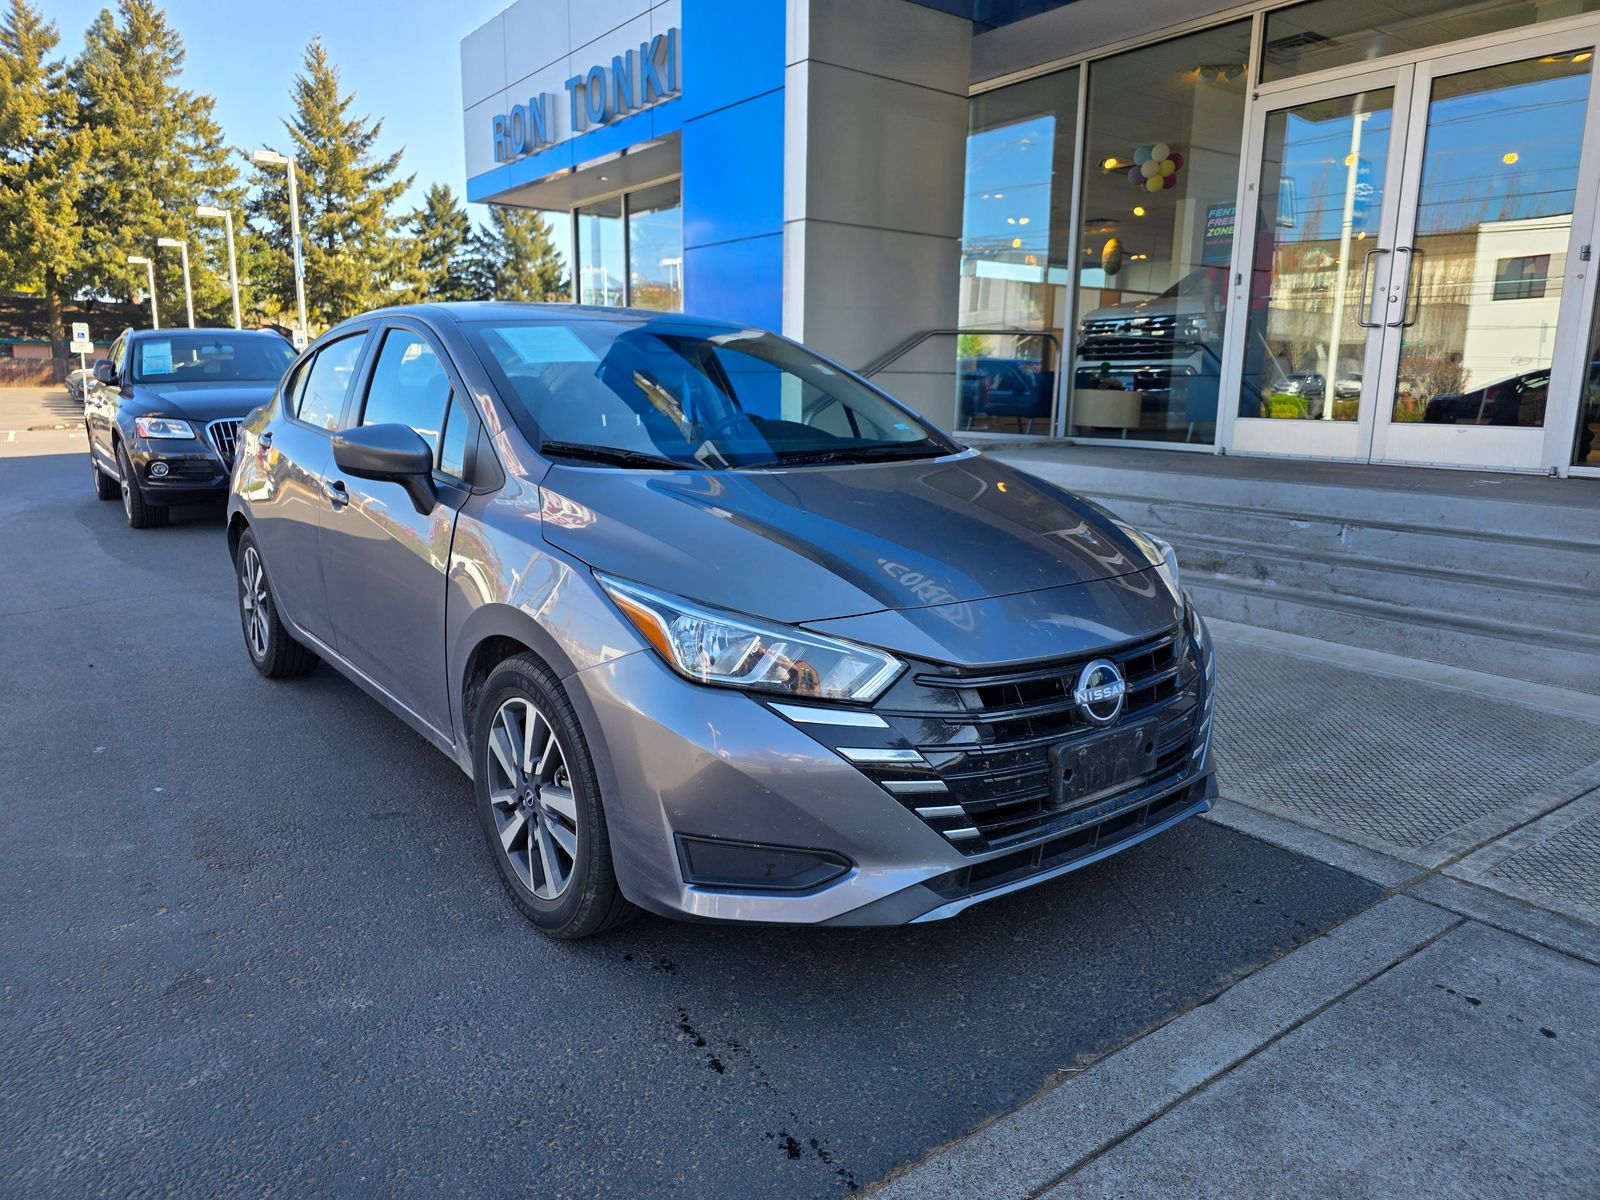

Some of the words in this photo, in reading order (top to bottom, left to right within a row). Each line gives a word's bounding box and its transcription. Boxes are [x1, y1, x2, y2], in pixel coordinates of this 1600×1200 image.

[492, 91, 548, 163] RON
[565, 26, 680, 133] TONKI
[1208, 206, 1236, 218] FENT
[1207, 216, 1235, 227] FREE
[1206, 225, 1235, 237] ZONE
[1076, 683, 1125, 703] NISSAN
